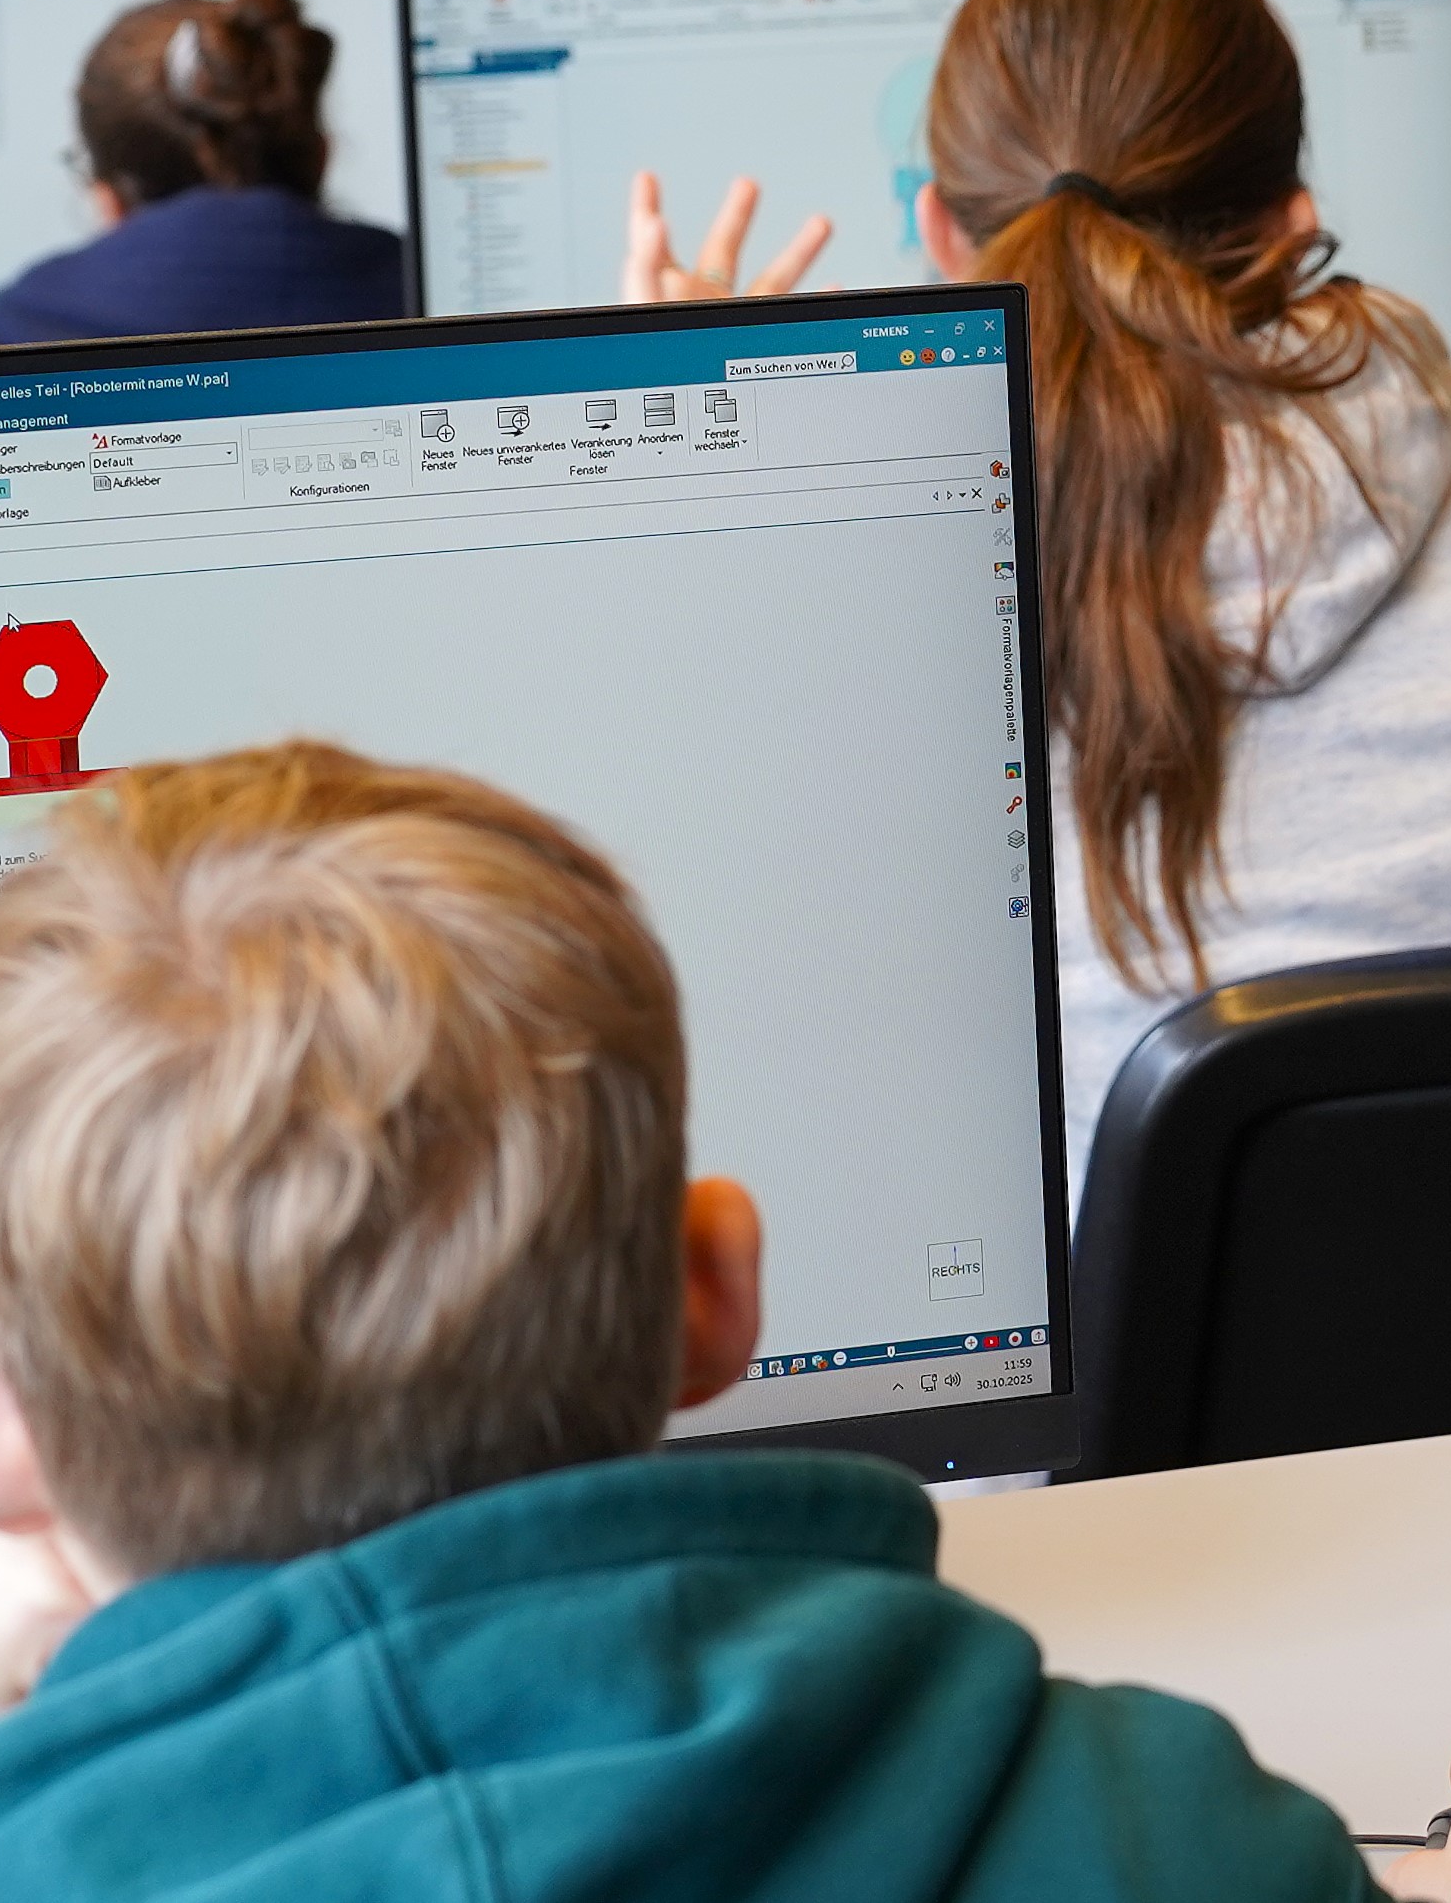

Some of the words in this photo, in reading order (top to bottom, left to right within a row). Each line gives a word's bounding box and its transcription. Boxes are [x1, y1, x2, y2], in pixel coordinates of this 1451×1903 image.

[862, 325, 908, 337] SIEMENS
[729, 365, 751, 376] Zum
[754, 362, 792, 374] Suchen
[794, 361, 814, 371] von
[35, 383, 59, 396] Teil
[147, 377, 183, 388] name
[185, 371, 228, 388] W.par]
[110, 432, 181, 448] Formatvorlage
[570, 437, 632, 448] Verankerung
[637, 432, 683, 443] Anordnen
[422, 449, 454, 459] Neues
[93, 456, 133, 468] Default
[421, 460, 457, 470] Fenster
[569, 464, 607, 475] Fenster
[113, 475, 161, 490] Aufkleber
[289, 483, 369, 497] Konfigurationen
[1001, 618, 1016, 742] Formatvorlagenpalette
[5, 856, 24, 865] zum
[1004, 1357, 1031, 1370] 11:59
[976, 1373, 1032, 1389] 30.10.2025
